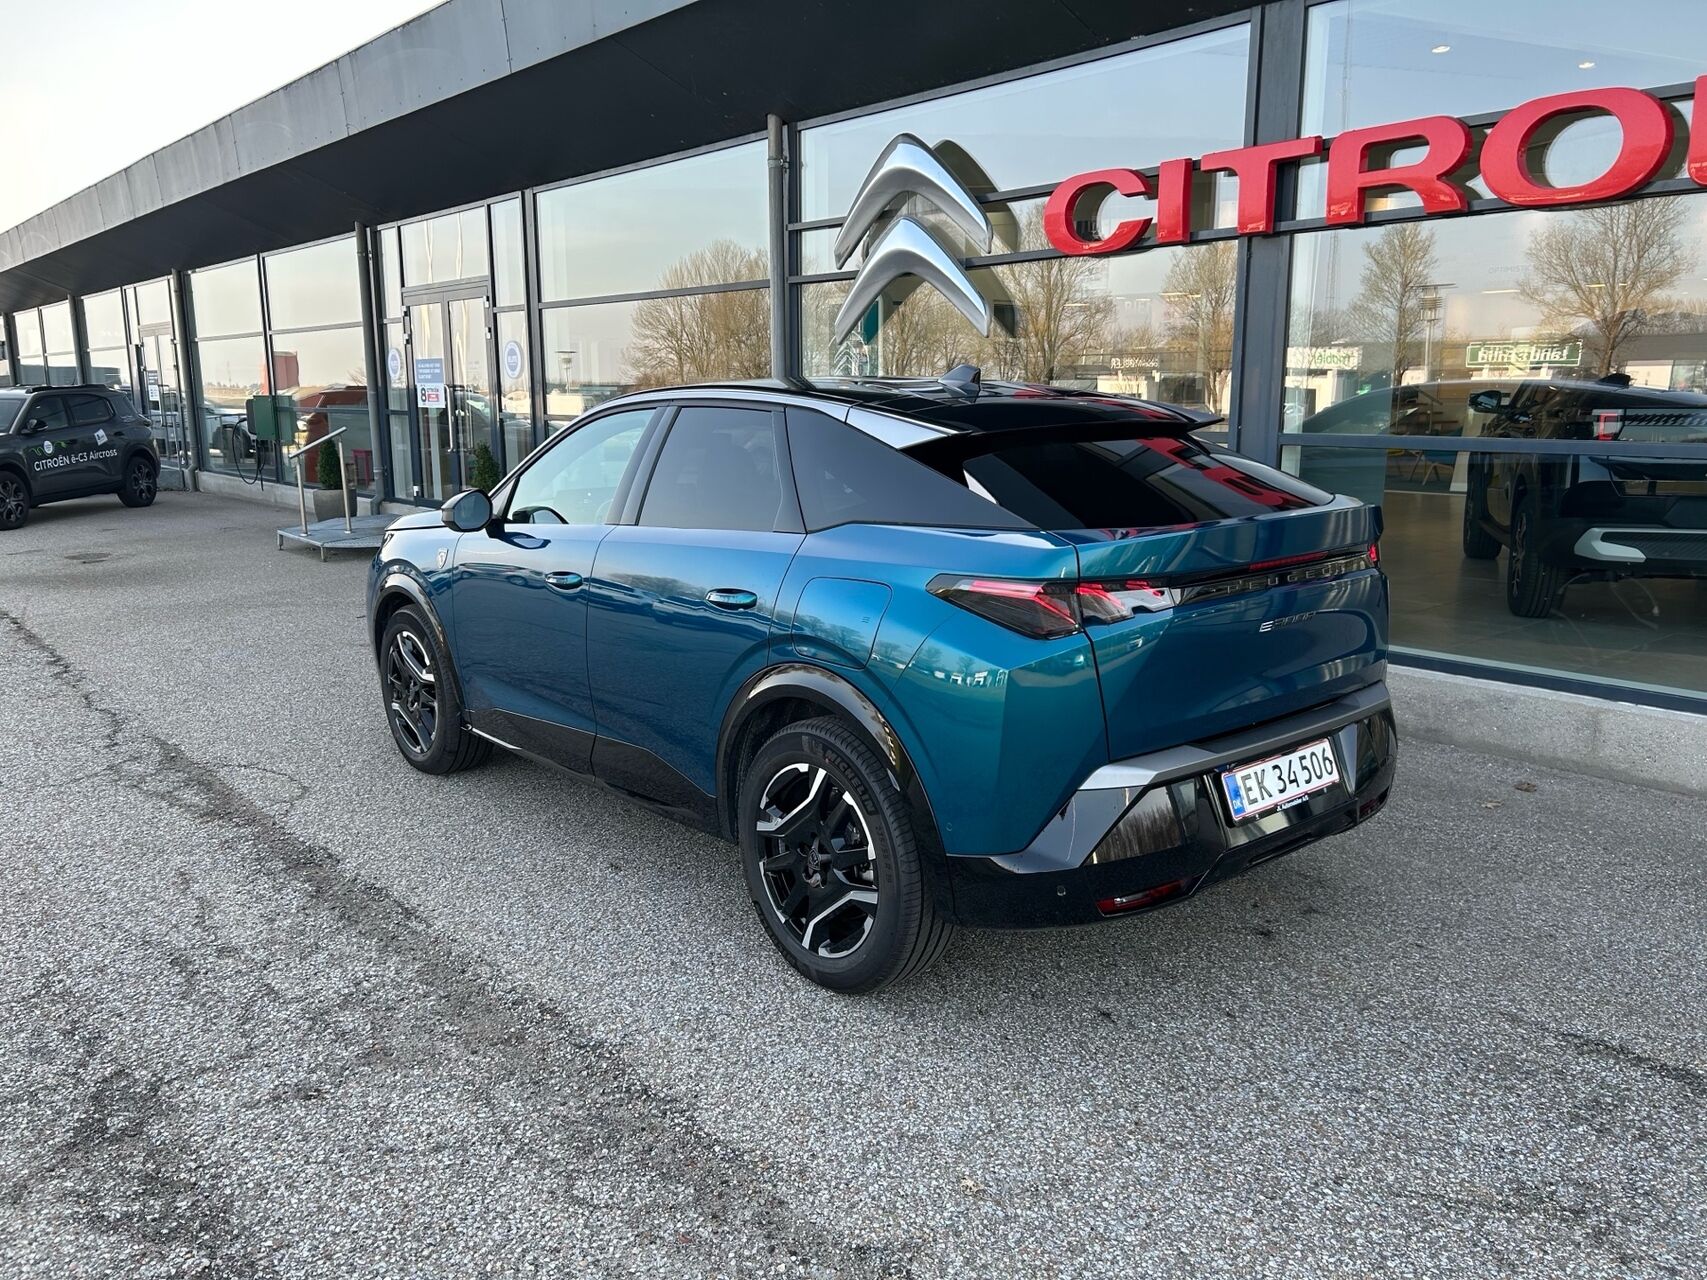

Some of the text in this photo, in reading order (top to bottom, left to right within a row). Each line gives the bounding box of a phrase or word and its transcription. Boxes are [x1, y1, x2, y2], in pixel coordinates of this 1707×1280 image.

[1044, 72, 1707, 256] CITRO
[34, 455, 70, 471] CITROËN
[89, 448, 117, 460] Aircross
[826, 748, 876, 815] MICHELIN
[1240, 769, 1272, 805] EK
